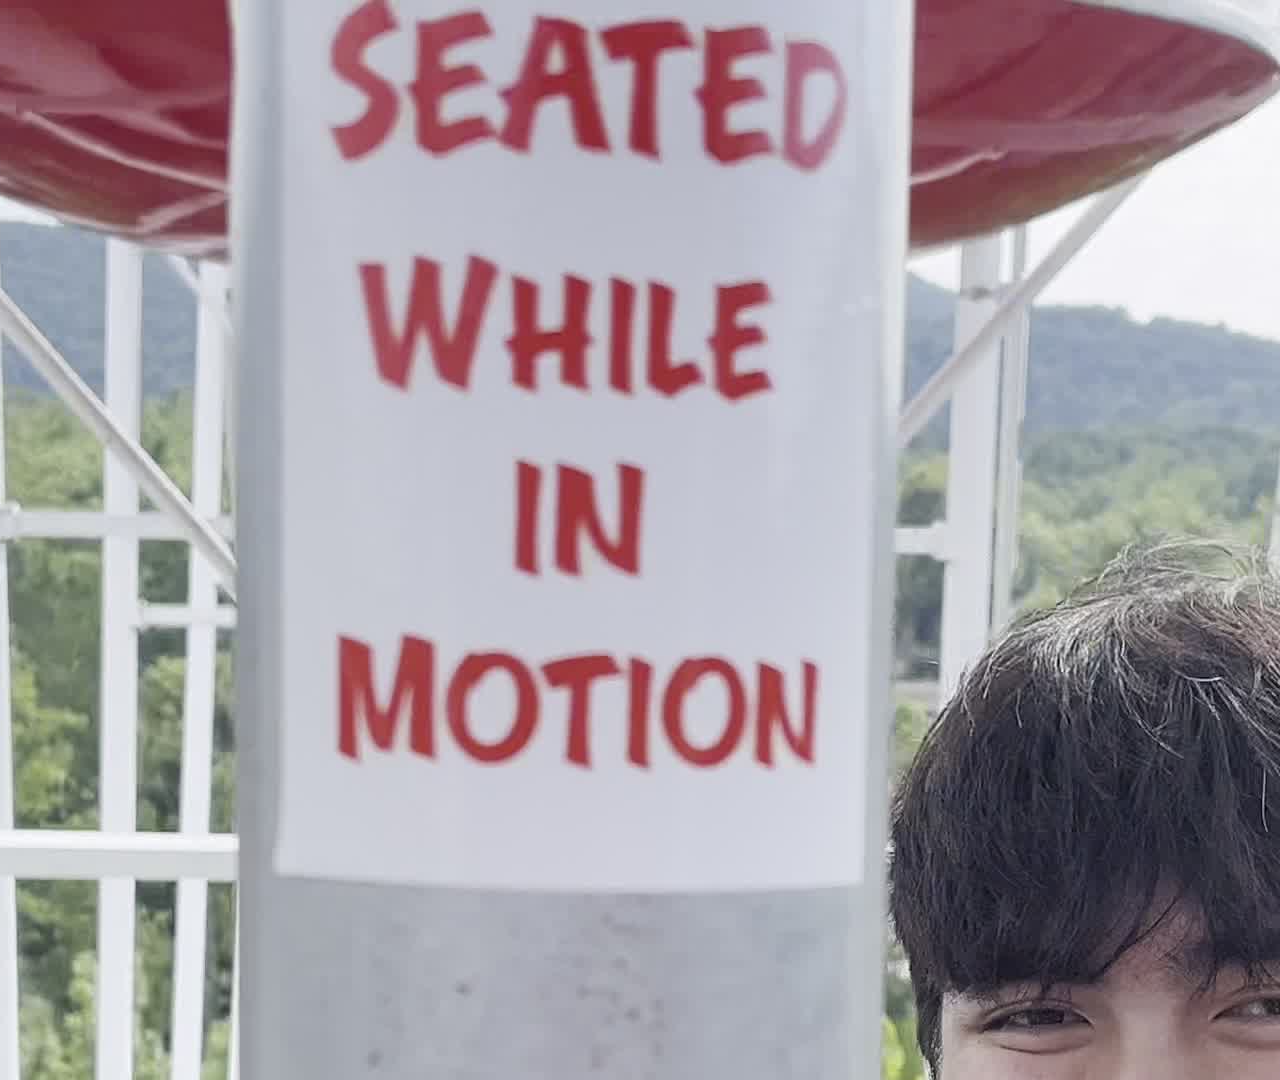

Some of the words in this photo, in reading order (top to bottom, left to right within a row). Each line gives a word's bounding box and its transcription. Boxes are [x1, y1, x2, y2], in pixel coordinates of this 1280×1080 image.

[330, 0, 846, 171] SEATED
[357, 254, 773, 403] WHILE
[514, 459, 646, 577] IN
[337, 634, 819, 770] MOTION
